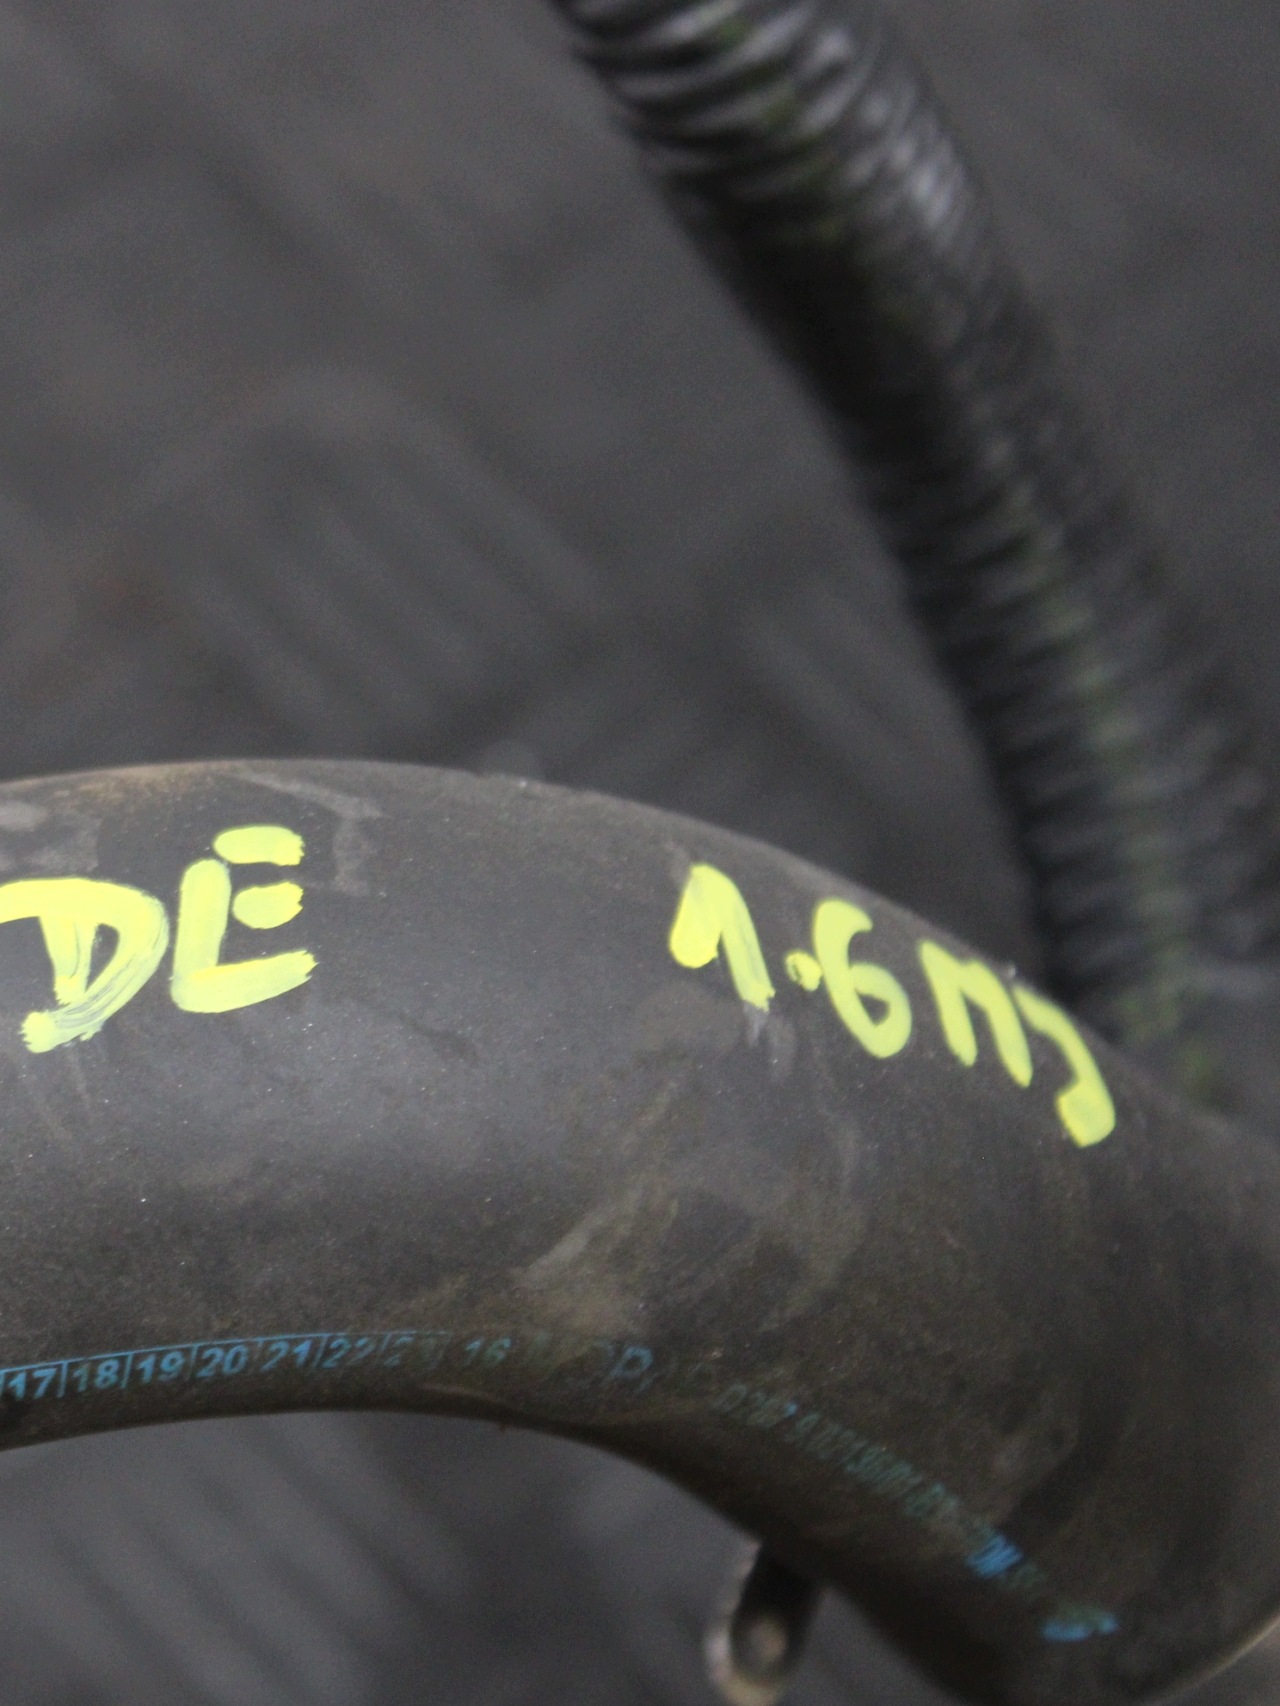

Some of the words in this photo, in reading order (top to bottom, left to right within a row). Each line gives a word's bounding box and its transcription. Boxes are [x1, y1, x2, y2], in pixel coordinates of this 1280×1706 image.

[8, 1368, 57, 1399] 17
[73, 1358, 120, 1393] 18
[138, 1352, 184, 1384] 19
[199, 1343, 248, 1377] 20
